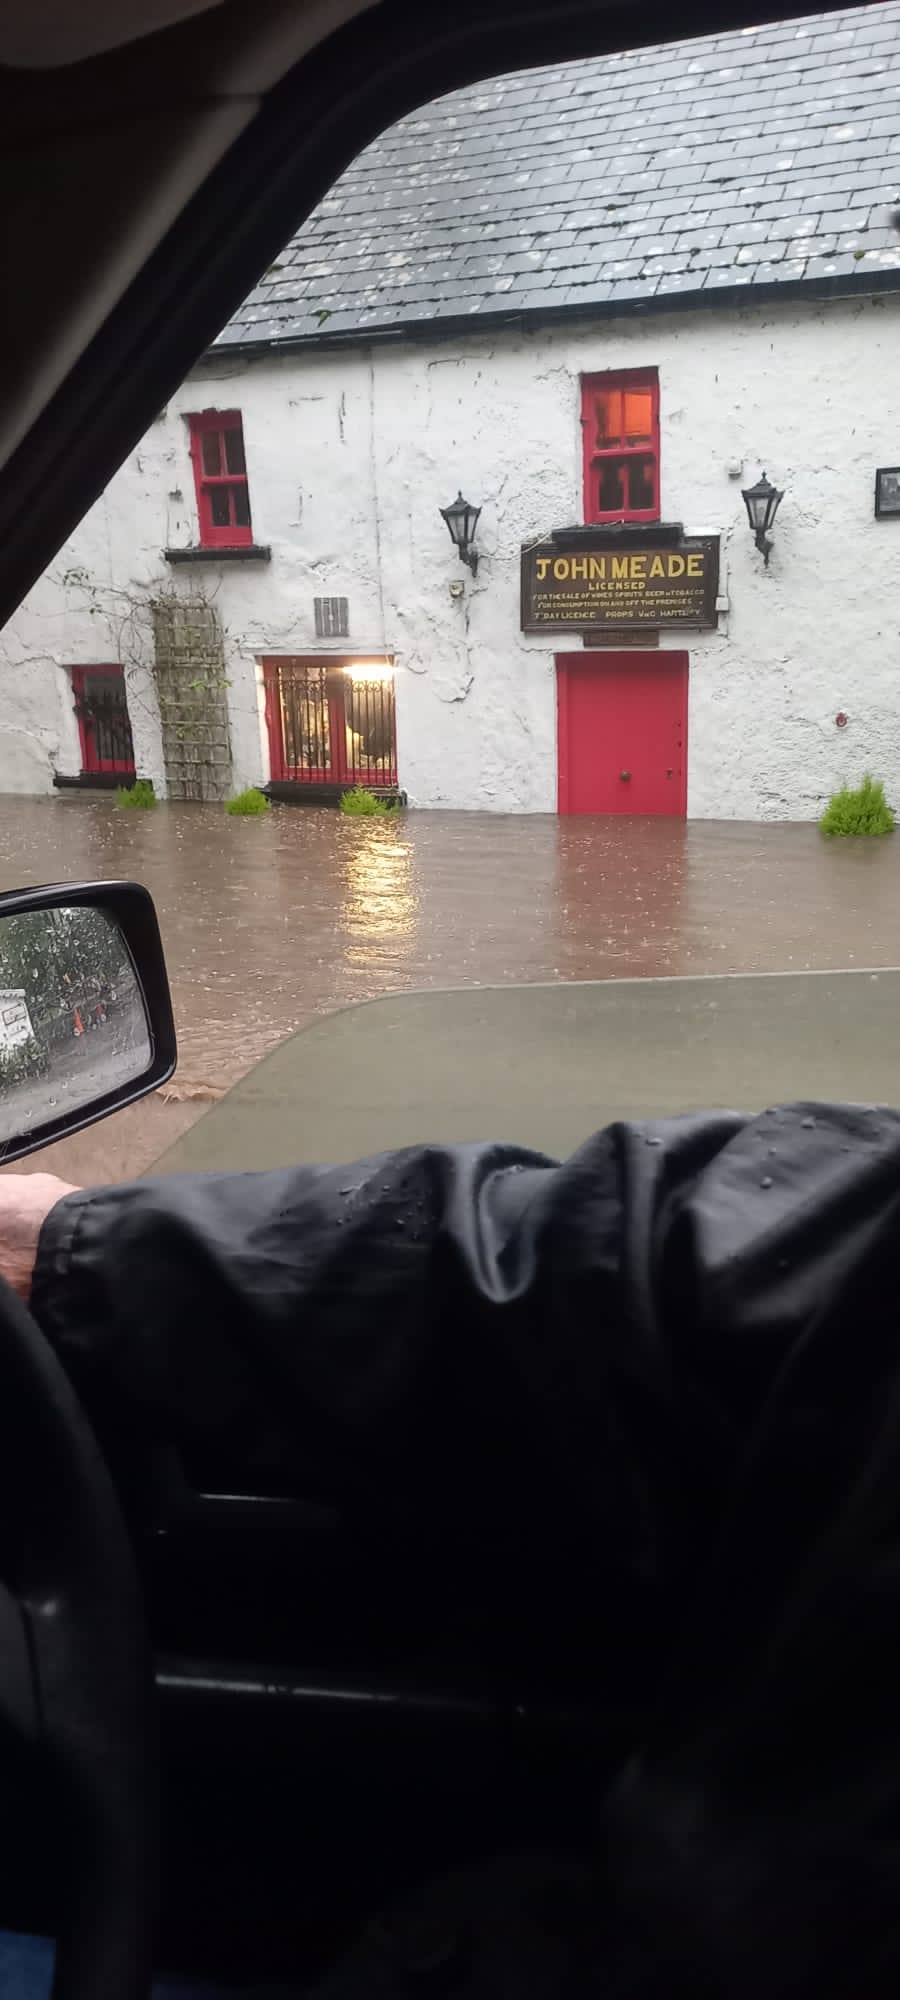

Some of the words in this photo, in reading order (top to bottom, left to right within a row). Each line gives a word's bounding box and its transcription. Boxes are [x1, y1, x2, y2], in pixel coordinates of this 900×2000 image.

[536, 557, 606, 580] JOHN
[612, 553, 704, 579] MEADE
[588, 581, 646, 591] LICENSED
